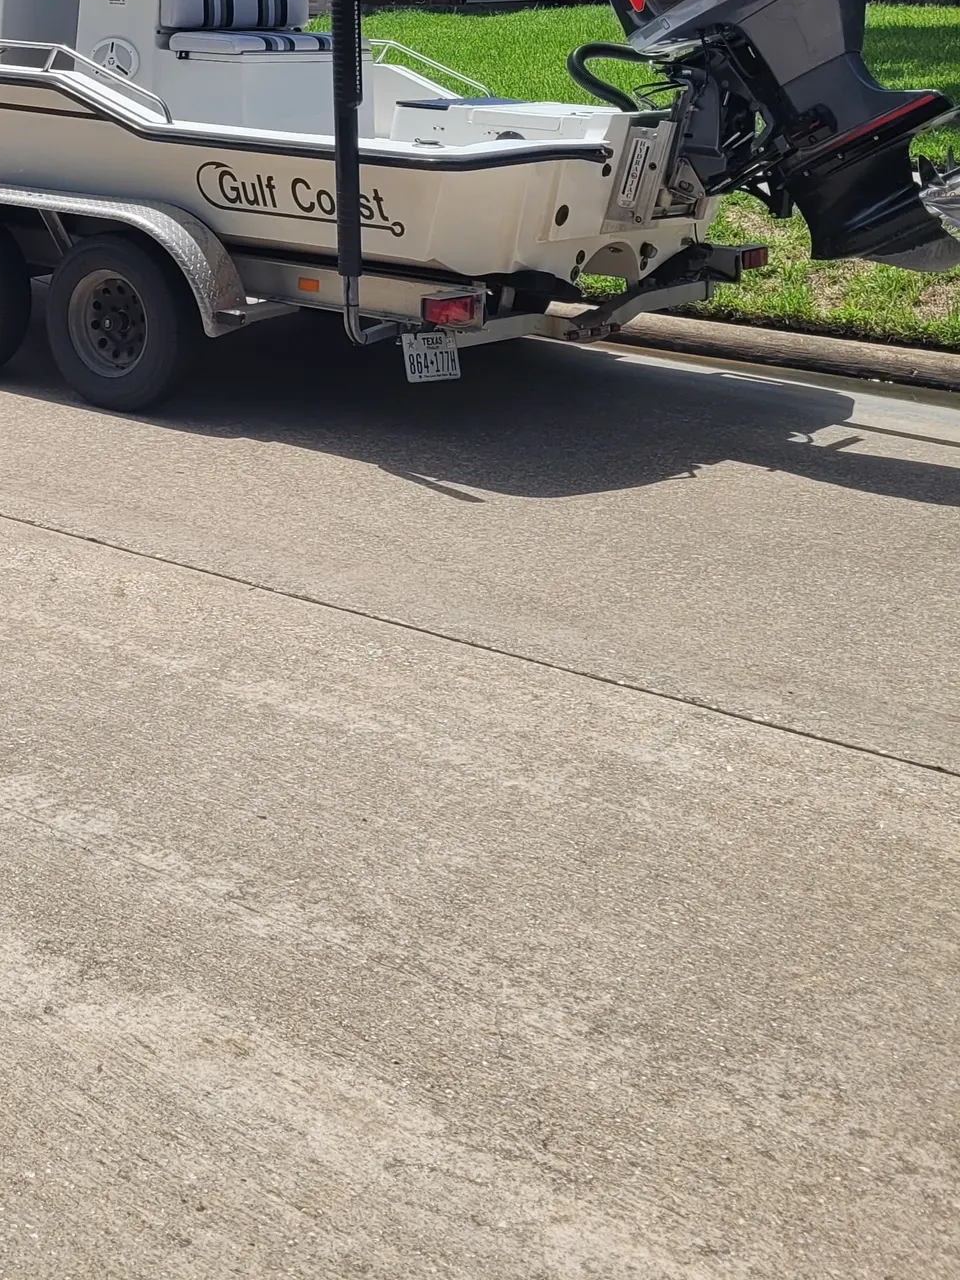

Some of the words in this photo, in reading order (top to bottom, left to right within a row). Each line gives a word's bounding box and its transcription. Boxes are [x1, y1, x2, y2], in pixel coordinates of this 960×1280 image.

[218, 169, 278, 209] Gulf
[290, 176, 390, 222] Cost
[421, 336, 443, 346] TEXAS
